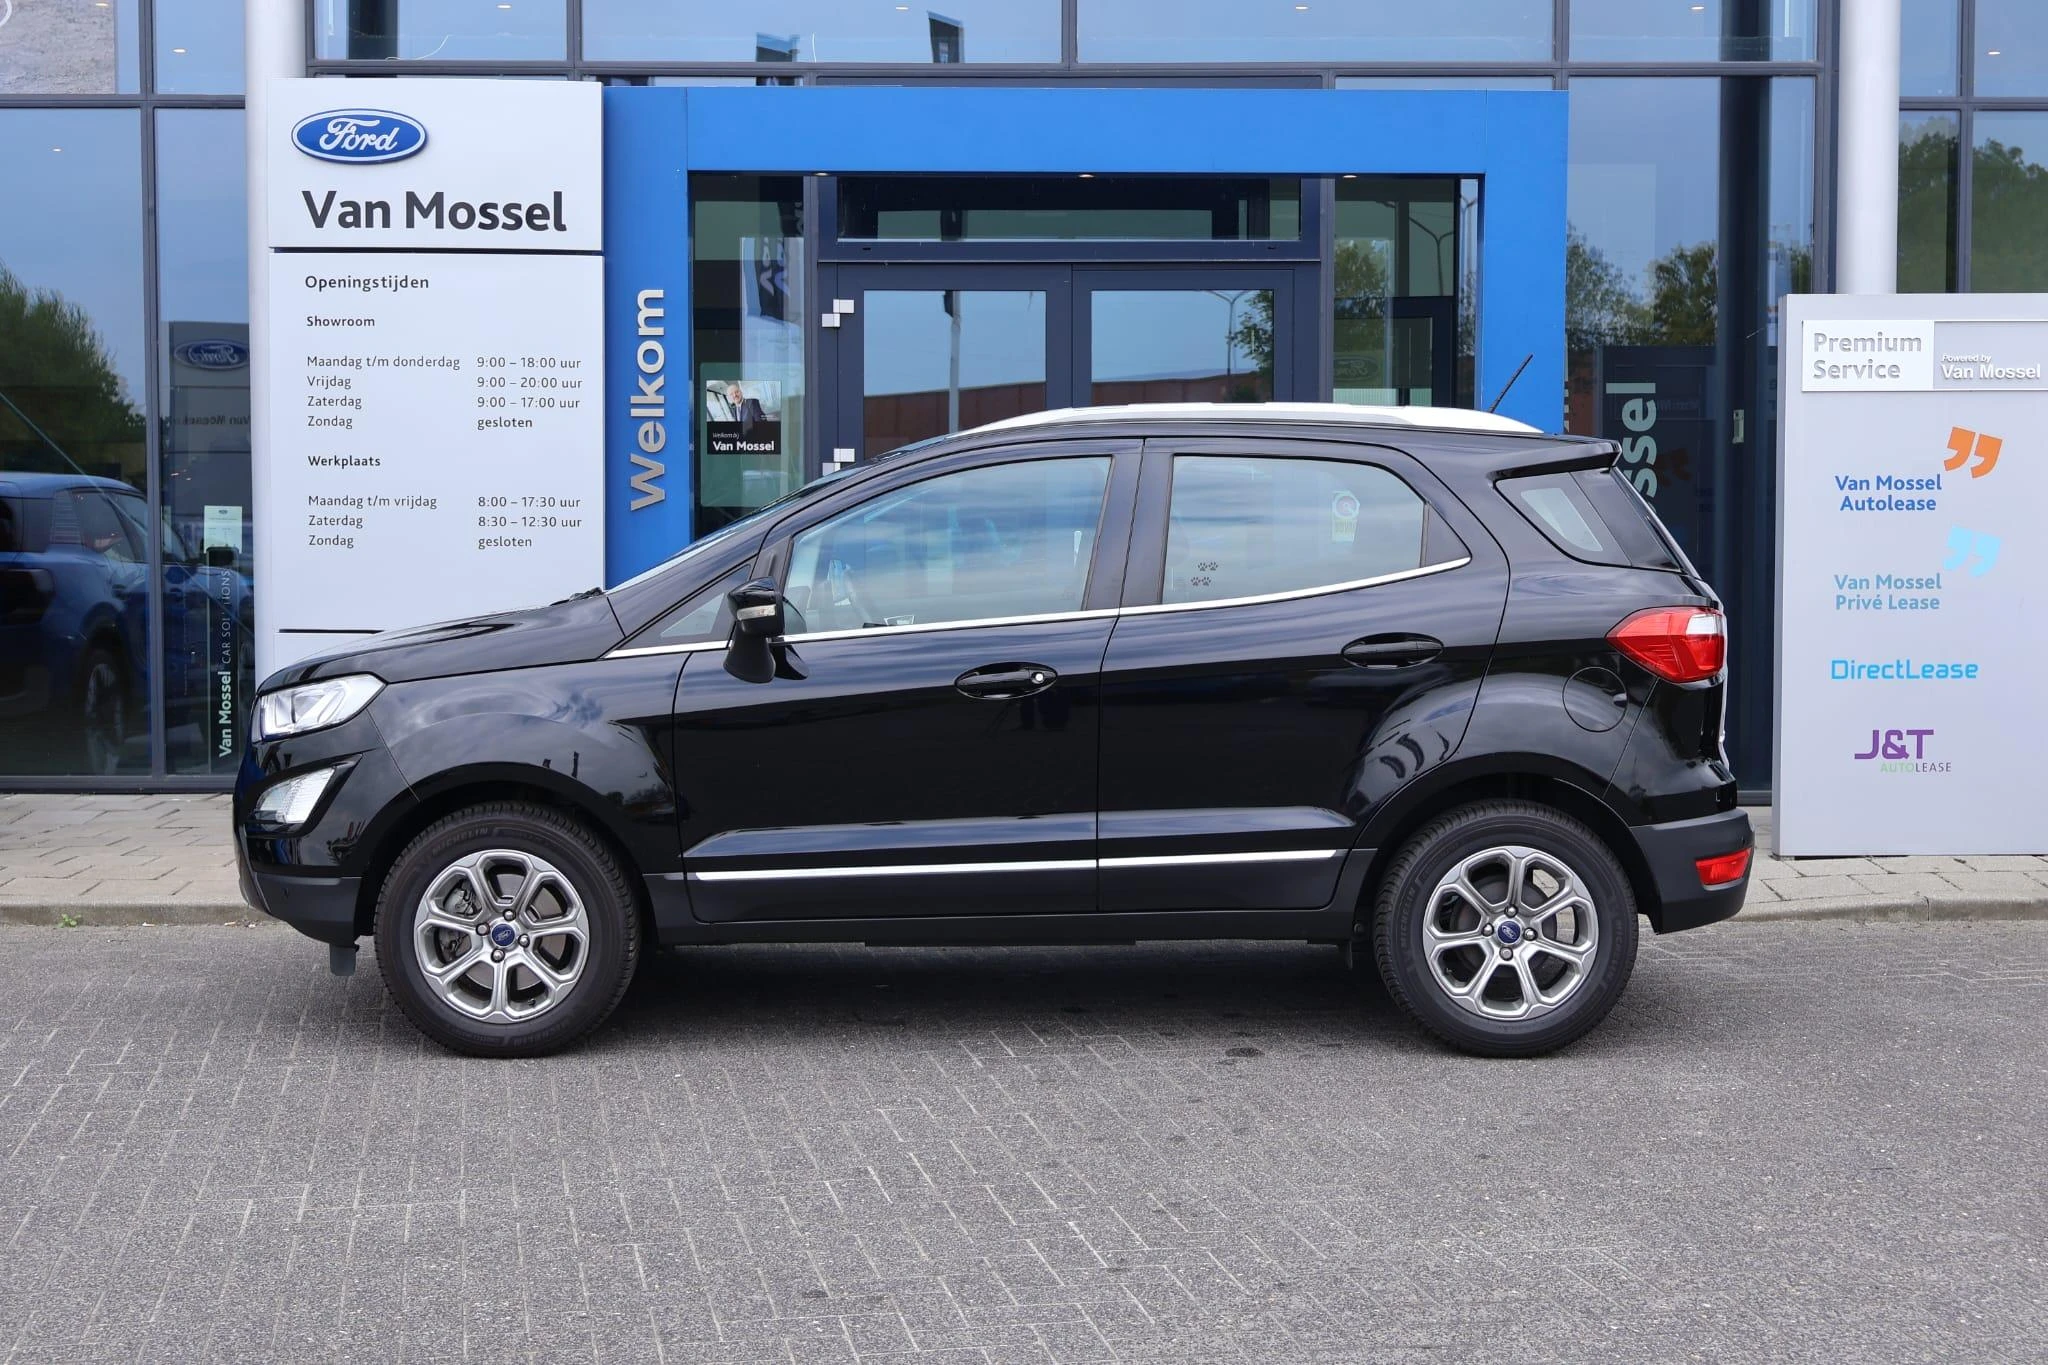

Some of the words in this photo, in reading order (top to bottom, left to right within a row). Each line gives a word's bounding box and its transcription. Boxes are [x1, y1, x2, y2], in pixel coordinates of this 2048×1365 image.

[319, 117, 401, 152] Ford
[301, 190, 391, 229] Van
[405, 190, 568, 232] Mossel
[304, 274, 429, 292] Openingstijden
[306, 315, 375, 327] Showroom
[1812, 331, 1922, 352] Premium
[307, 355, 362, 370] Maandag
[366, 355, 389, 367] t/m
[393, 355, 461, 371] donderdag
[477, 356, 506, 368] 9:00
[521, 357, 556, 369] 18:00
[560, 360, 582, 369] uur
[1941, 353, 1978, 363] Powered
[1980, 353, 1992, 364] by
[1812, 358, 1902, 379] Service
[1941, 364, 1974, 379] Van
[1979, 363, 2041, 380] Mossel
[307, 375, 352, 390] Vrijdag
[477, 376, 506, 388] 9:00
[520, 377, 558, 389] 20:00
[562, 380, 583, 389] uur
[307, 395, 362, 410] Zaterdag
[477, 396, 506, 408] 9:00
[521, 397, 555, 409] 17:00
[559, 400, 581, 409] uur
[630, 289, 666, 512] Welkom
[307, 415, 353, 430] Zondag
[477, 416, 533, 431] gesloten
[712, 440, 733, 451] Van
[736, 440, 775, 451] Mossel
[1605, 382, 1658, 513] ssel
[307, 454, 381, 469] Werkplaats
[1834, 475, 1870, 491] Van
[1876, 473, 1943, 491] Mossel
[308, 494, 364, 509] Maandag
[367, 495, 390, 507] t/m
[394, 495, 438, 510] vrijdag
[478, 496, 507, 508] 8:00
[522, 496, 556, 508] 17:30
[560, 499, 581, 508] uur
[1839, 494, 1937, 512] Autolease
[308, 514, 364, 529] Zaterdag
[478, 516, 507, 527] 8:30
[521, 516, 557, 528] 12:30
[561, 519, 582, 528] uur
[308, 534, 354, 549] Zondag
[478, 535, 532, 550] gesloten
[1834, 574, 1870, 590] Van
[1876, 572, 1943, 590] Mossel
[1835, 593, 1883, 610] Privé
[1888, 594, 1941, 610] Lease
[222, 642, 231, 664] CAR
[1831, 658, 1980, 680] DirectLease
[217, 670, 232, 724] Mossel
[219, 728, 232, 758] Van
[1854, 729, 1935, 760] J&T
[1880, 761, 1952, 773] AUTOLEASE
